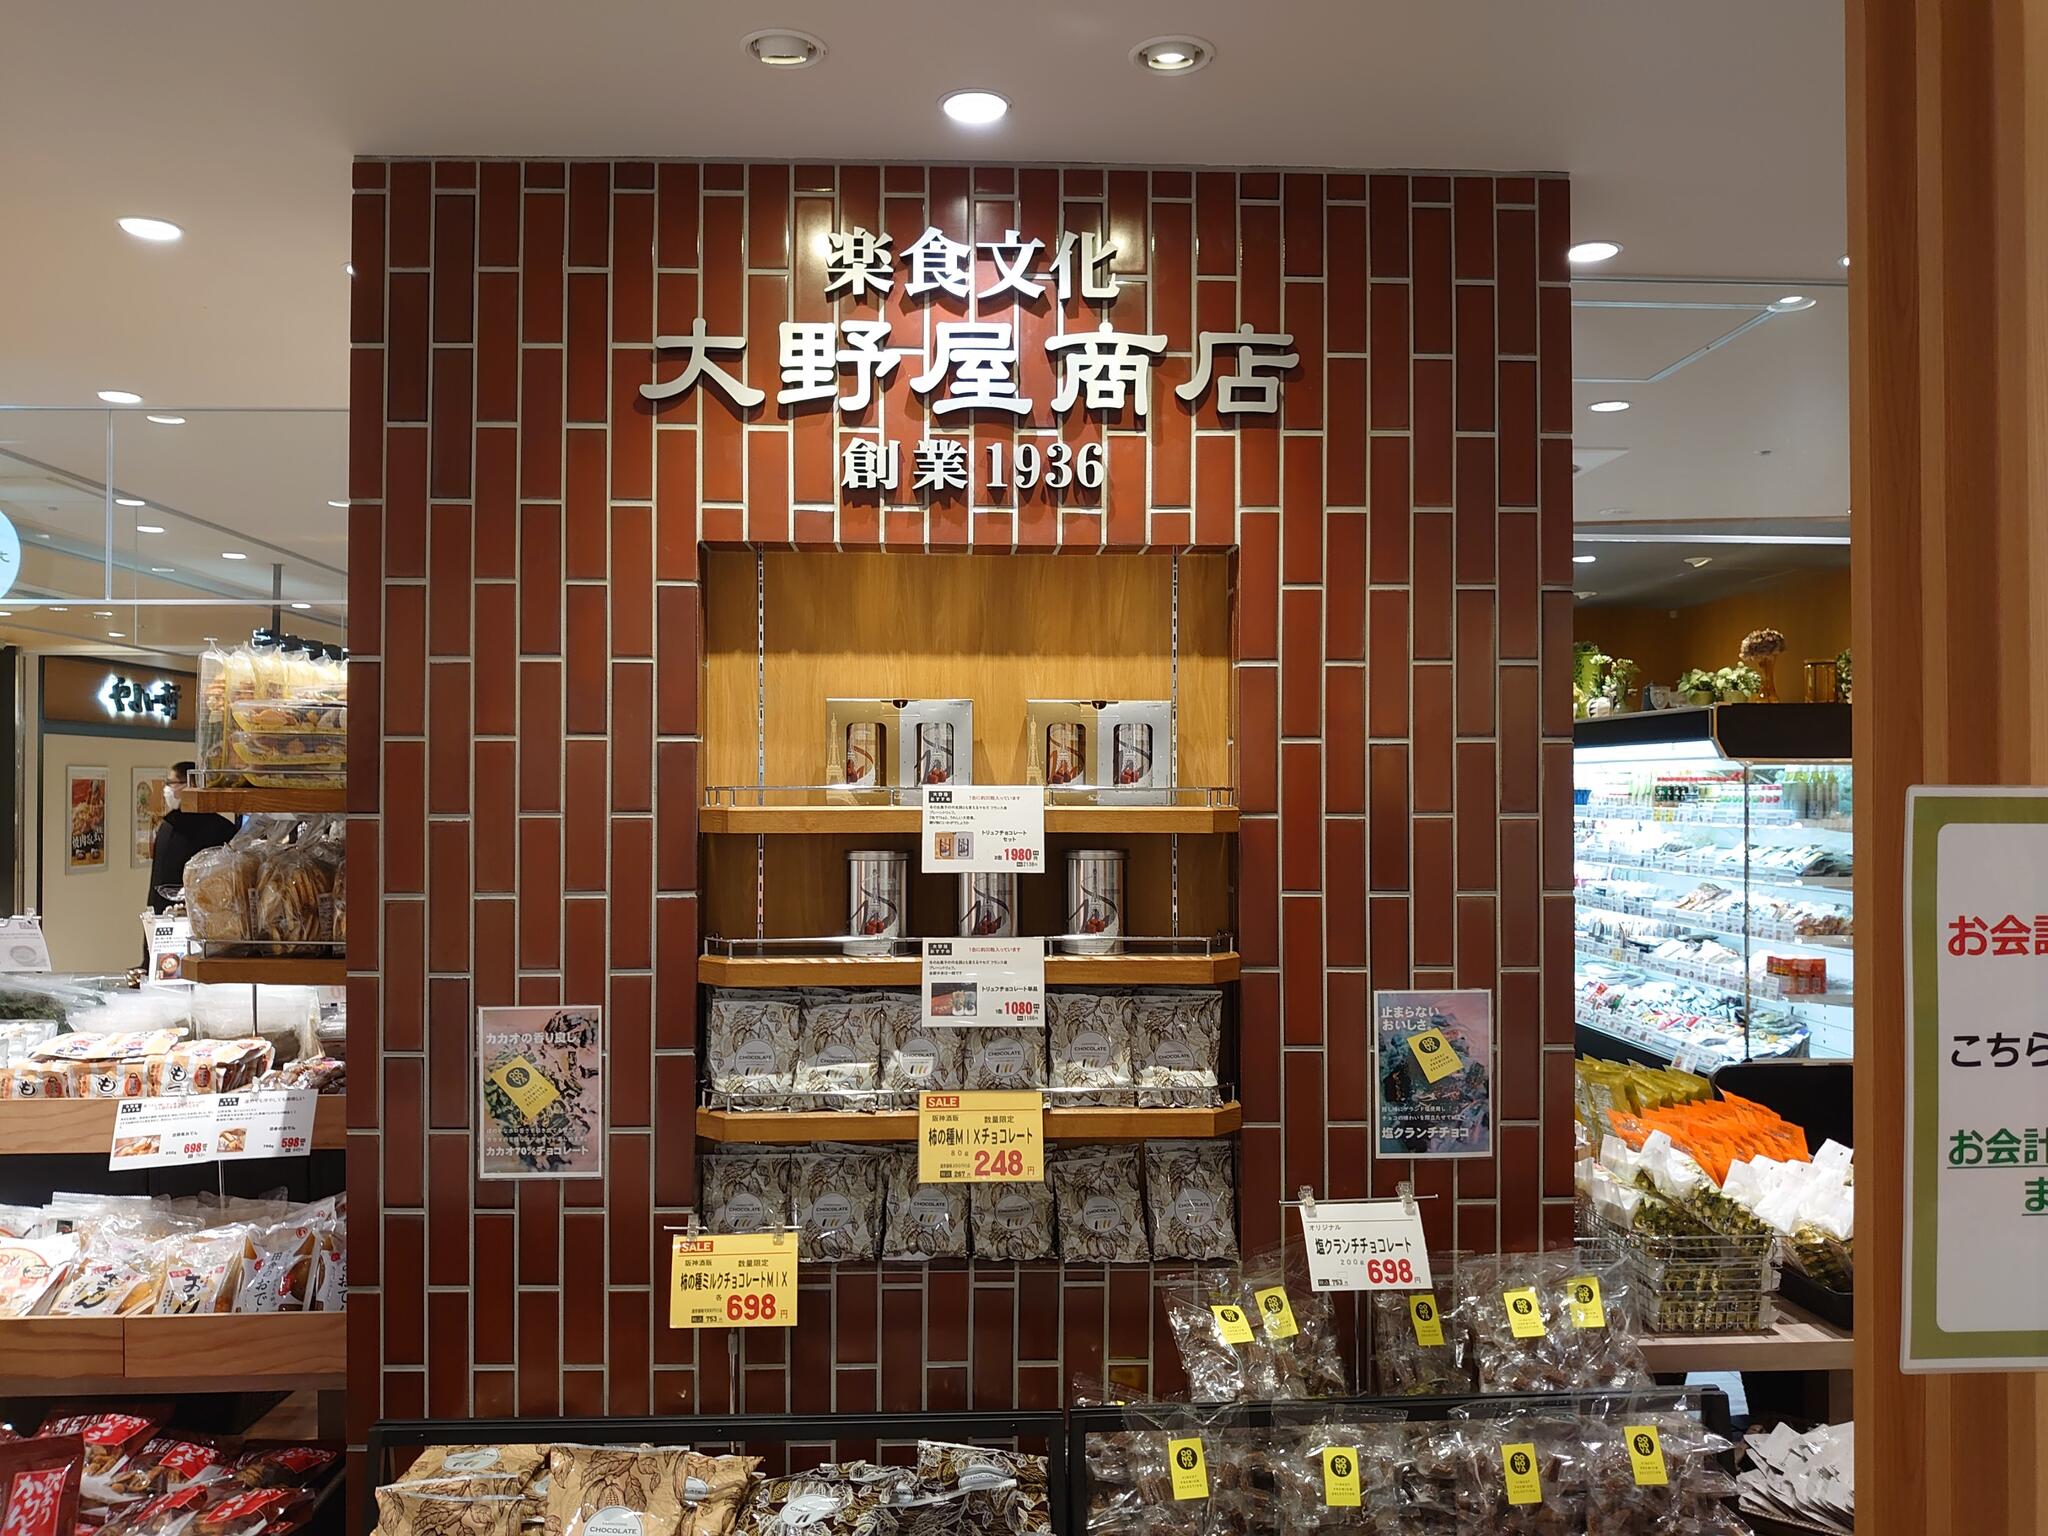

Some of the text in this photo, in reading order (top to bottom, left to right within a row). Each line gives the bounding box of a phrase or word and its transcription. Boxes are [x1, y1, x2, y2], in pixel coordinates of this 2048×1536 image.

[824, 228, 1120, 300] 楽食文化
[638, 317, 1300, 417] 大野屋商店
[1004, 848, 1032, 860] 1980
[1004, 1002, 1032, 1015] 1080
[1381, 1006, 1440, 1018] 止まらない
[928, 1098, 958, 1107] SALE
[1382, 1127, 1469, 1139] 塩クランチチョコ
[281, 1137, 299, 1148] 598
[486, 1147, 589, 1156] カカオ70%チョコレート
[974, 1150, 1035, 1176] 248 円
[681, 1243, 712, 1252] SALE
[1315, 1237, 1412, 1255] 塩クランチチョコレート
[1367, 1258, 1413, 1284] 698
[727, 1294, 788, 1320] 698 円
[589, 1526, 637, 1535] CHOCOLATE
